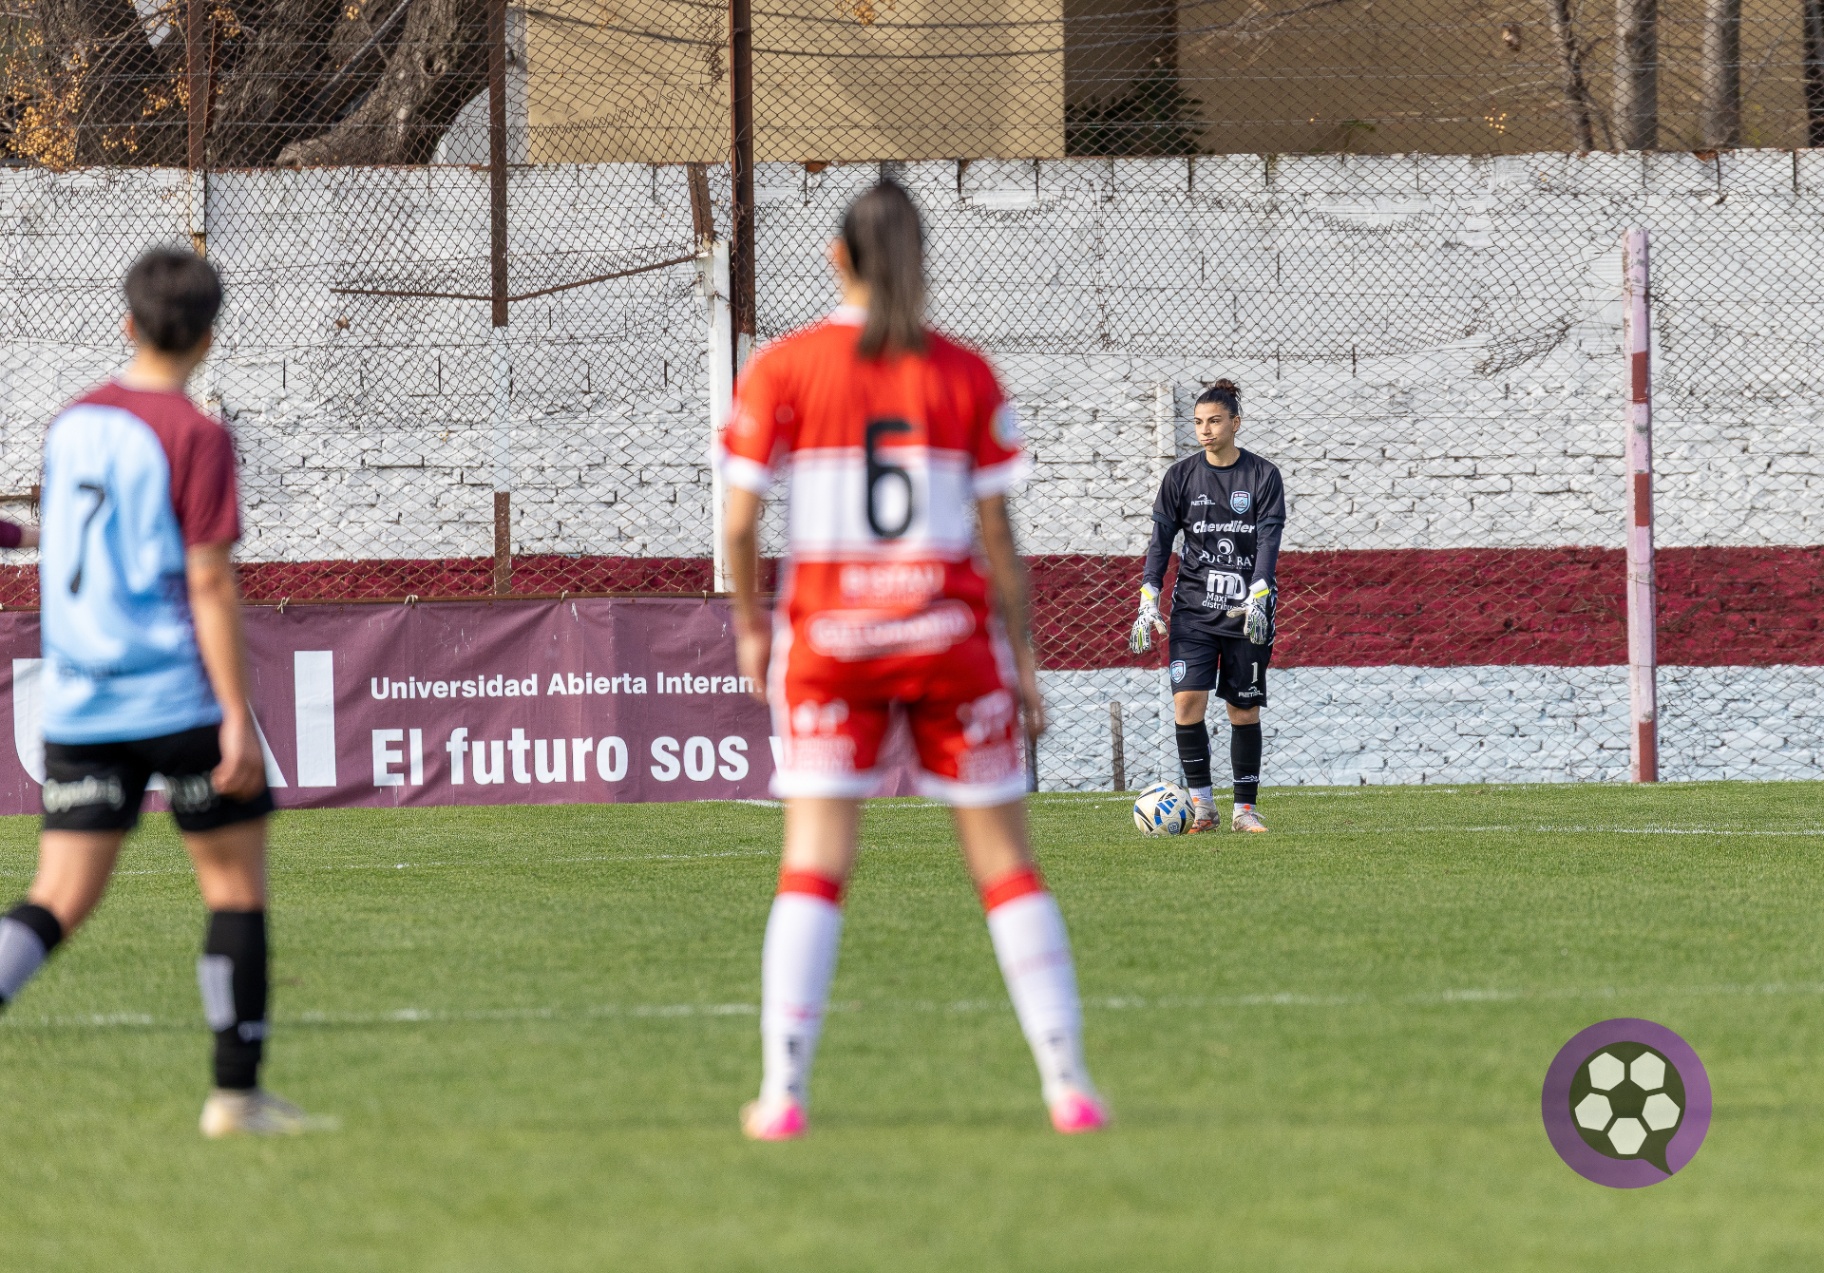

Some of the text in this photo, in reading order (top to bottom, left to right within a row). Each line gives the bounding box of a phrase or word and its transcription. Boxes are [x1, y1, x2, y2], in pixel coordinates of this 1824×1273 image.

[864, 418, 914, 539] 6
[70, 483, 105, 593] 7
[1192, 520, 1256, 534] Chevallier
[1206, 592, 1228, 603] Maxi
[370, 673, 538, 700] Universidad
[546, 672, 647, 696] Abierta
[1251, 661, 1258, 683] 1
[371, 728, 424, 787] El
[446, 726, 629, 785] futuro
[650, 735, 749, 782] sos
